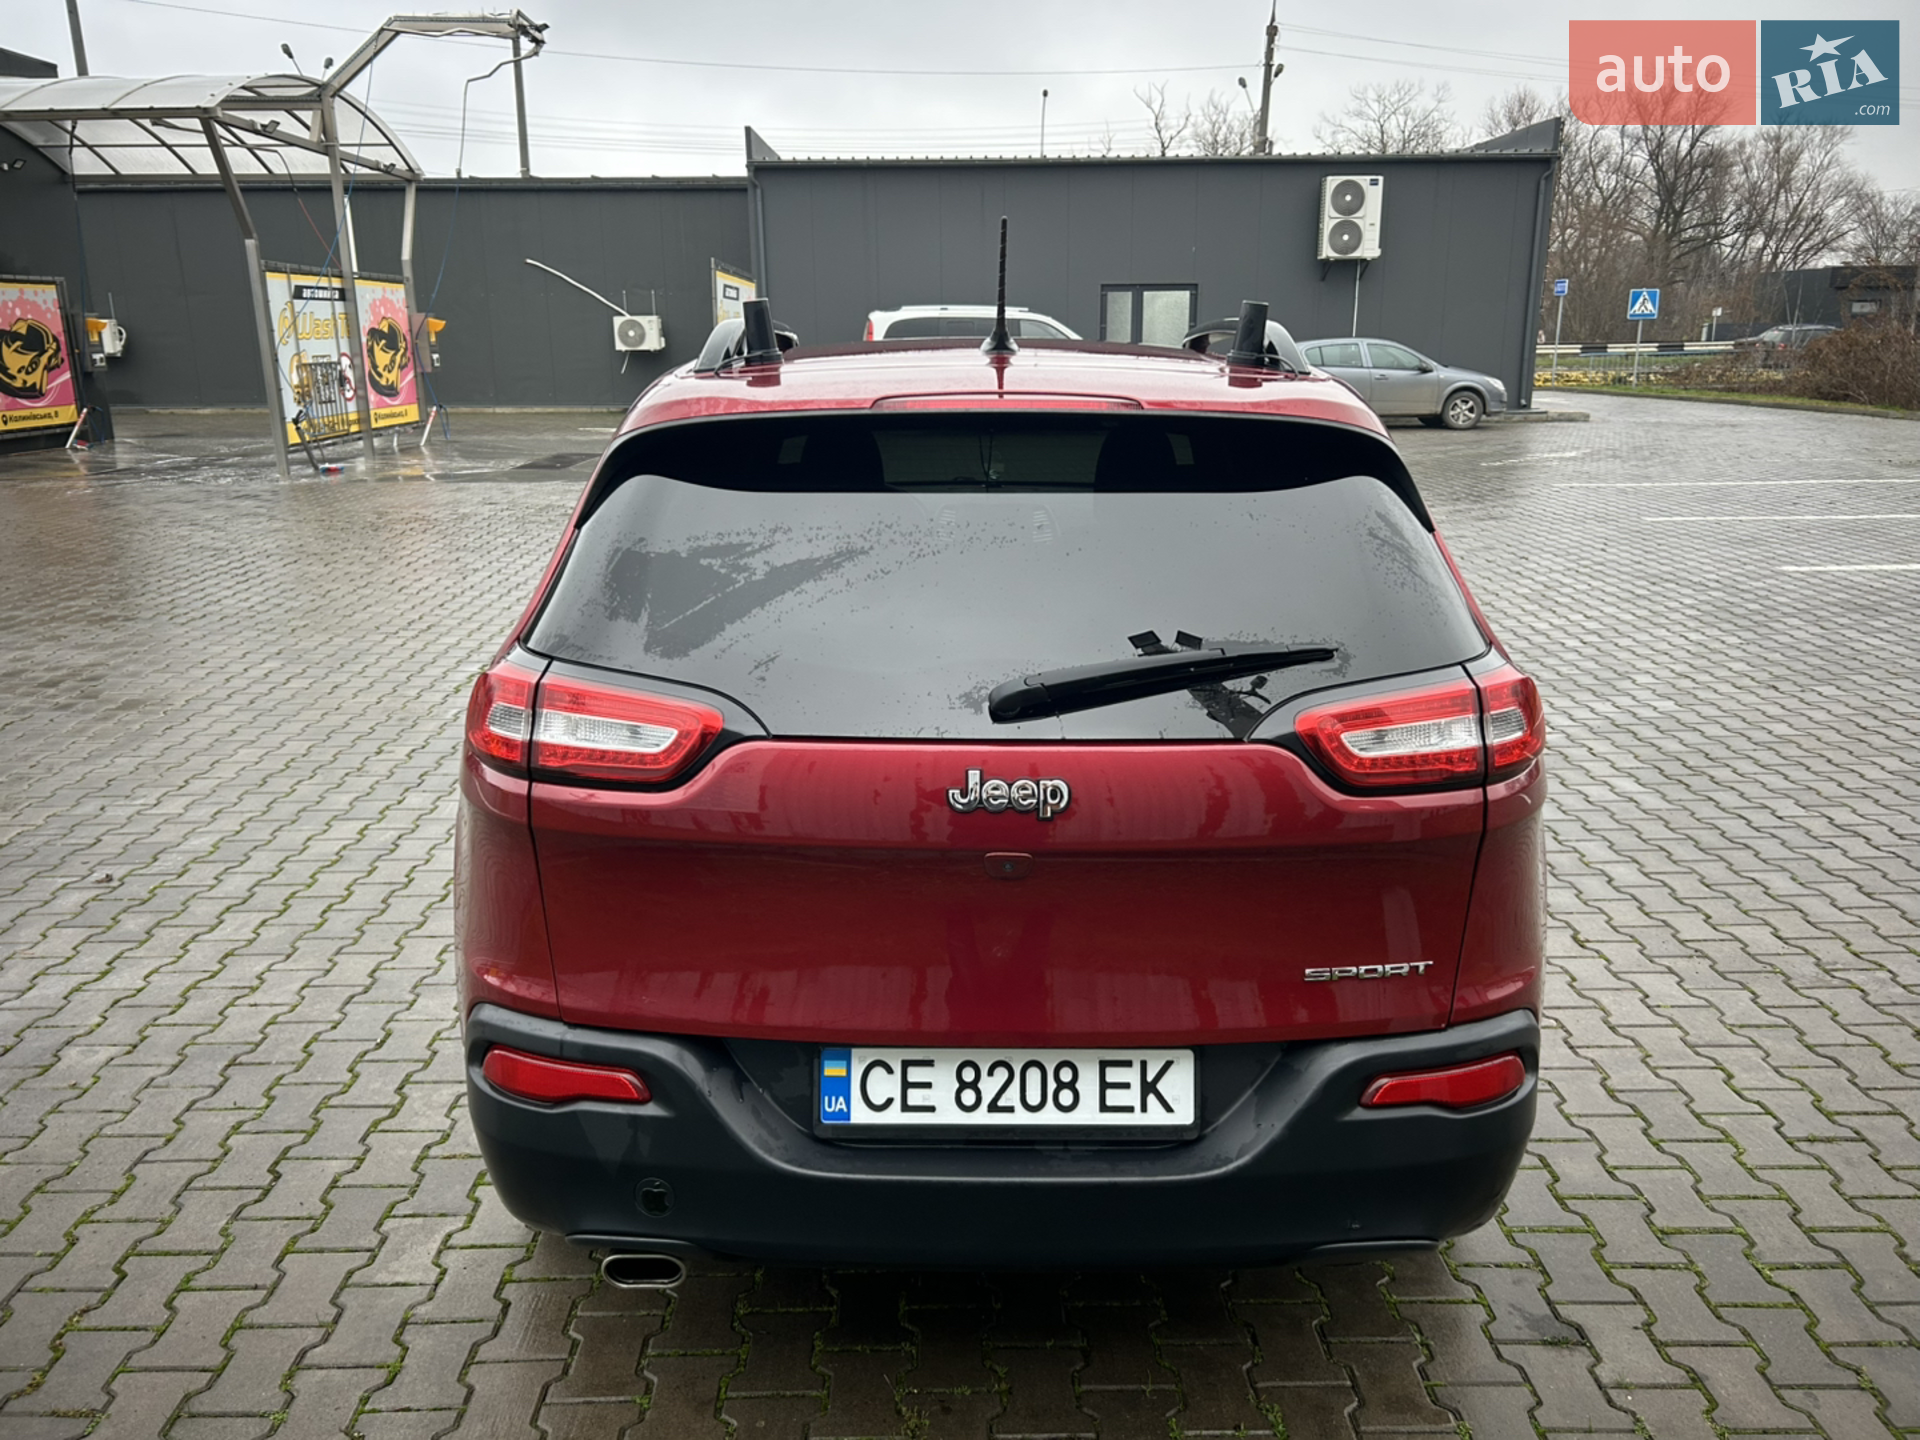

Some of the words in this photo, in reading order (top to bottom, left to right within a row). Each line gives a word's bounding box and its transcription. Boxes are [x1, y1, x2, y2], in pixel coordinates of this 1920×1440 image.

[947, 768, 1071, 820] Jeep
[1304, 961, 1434, 981] SPORT
[859, 1058, 936, 1113] CE
[954, 1058, 1079, 1113] 8208
[1098, 1058, 1175, 1113] EK
[824, 1096, 847, 1112] UA
